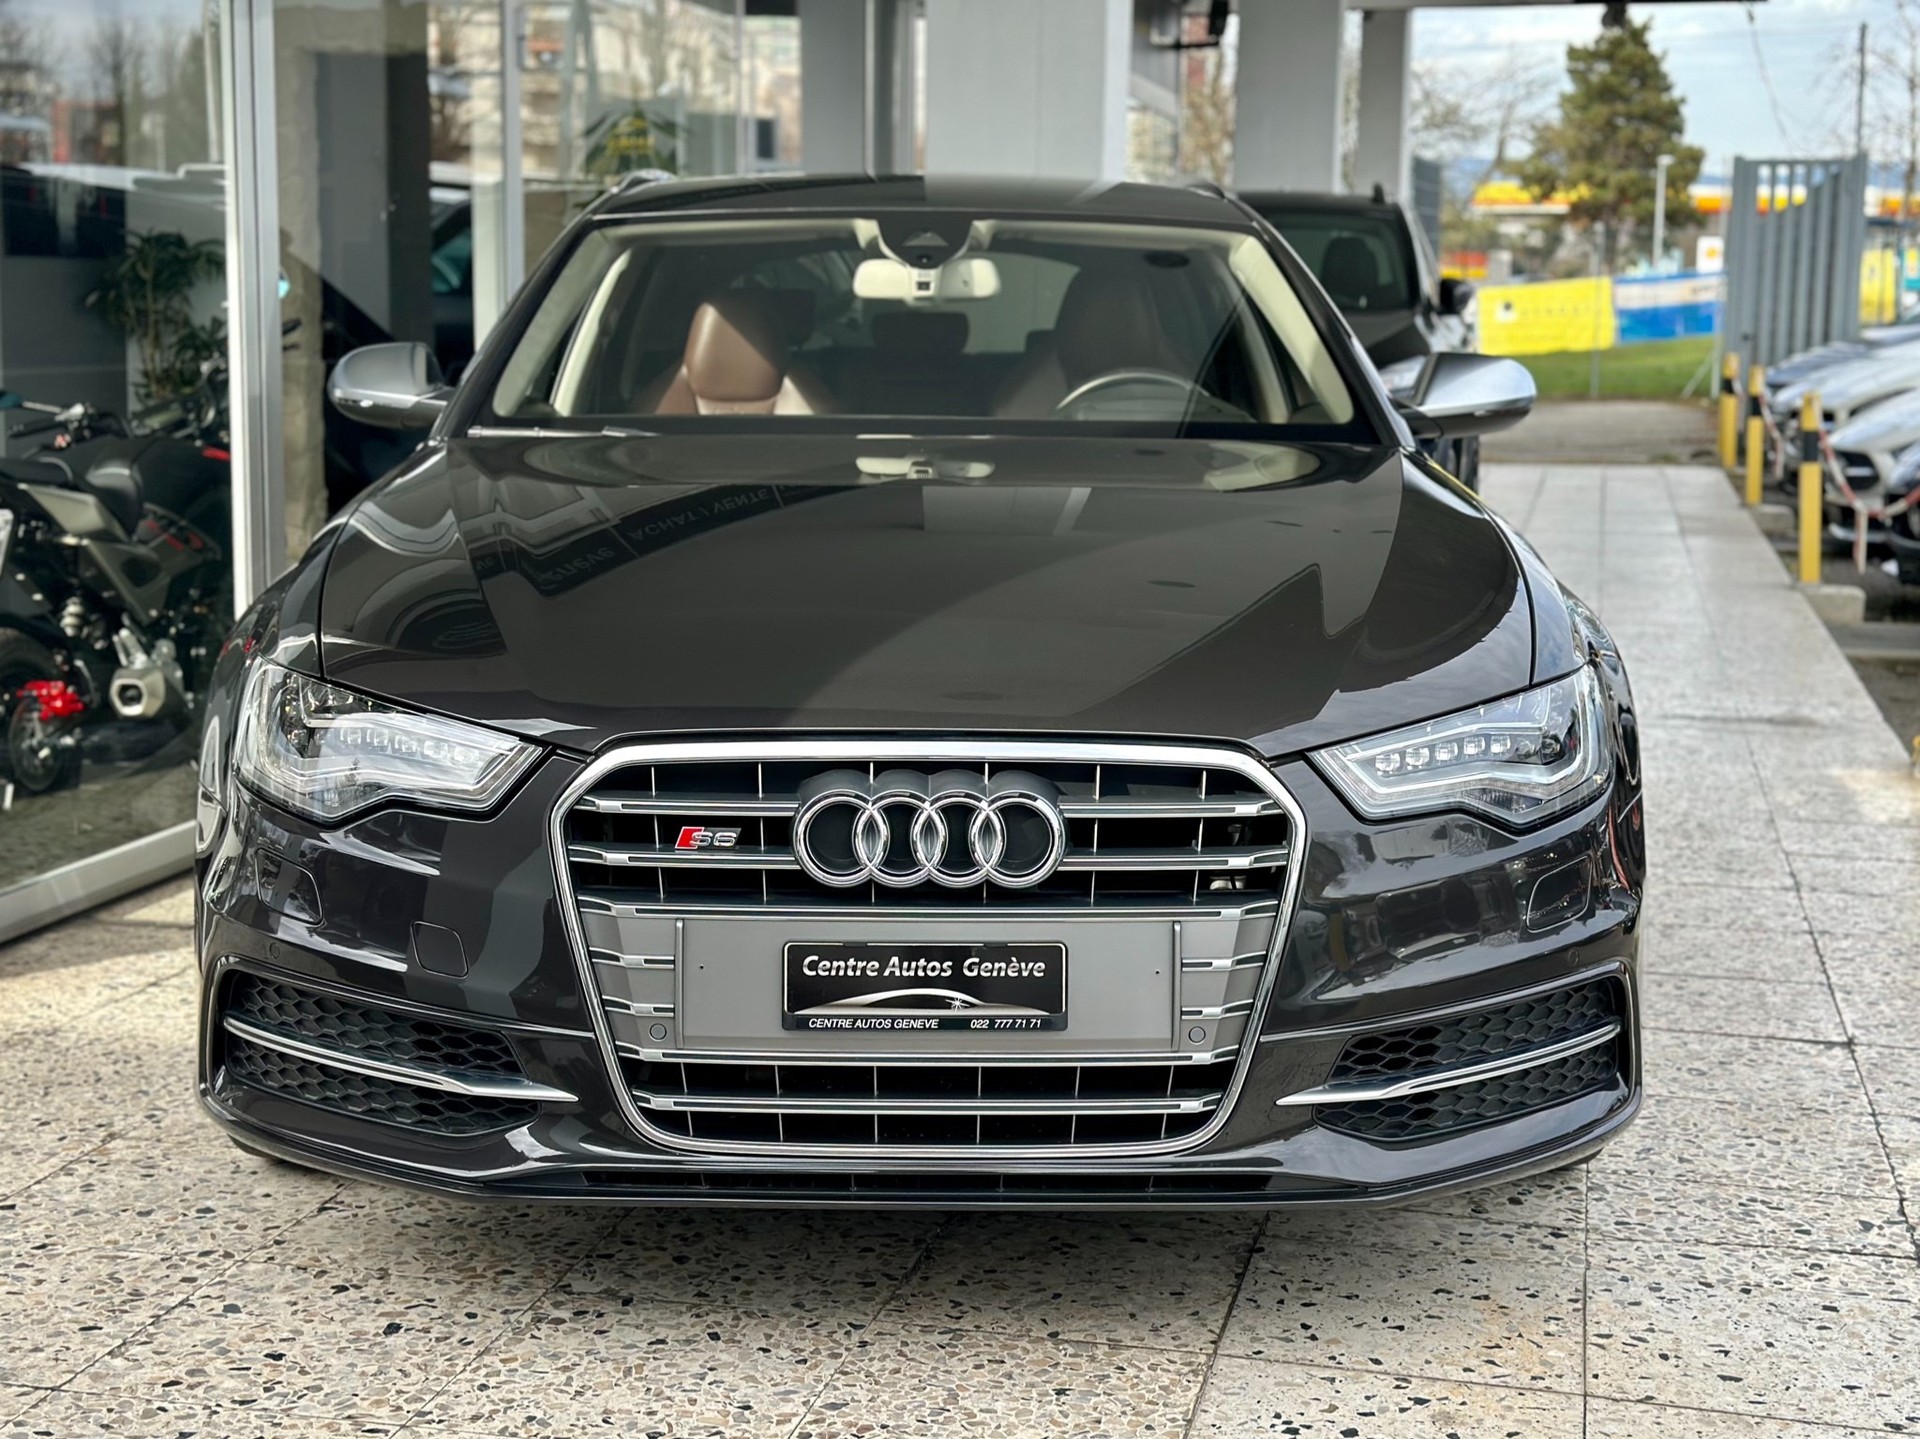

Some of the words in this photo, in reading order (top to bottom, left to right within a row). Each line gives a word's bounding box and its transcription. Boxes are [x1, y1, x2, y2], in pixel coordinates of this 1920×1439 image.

[689, 831, 737, 846] S6
[802, 955, 878, 977] Centre
[883, 956, 952, 977] Autos
[962, 957, 1046, 977] Genève
[808, 1018, 853, 1029] CENTRE
[854, 1018, 892, 1029] AUTOS
[894, 1018, 939, 1029] GENEVE
[970, 1019, 989, 1029] 022
[994, 1019, 1012, 1029] 777
[1015, 1019, 1027, 1029] 71
[1030, 1019, 1041, 1029] 71
